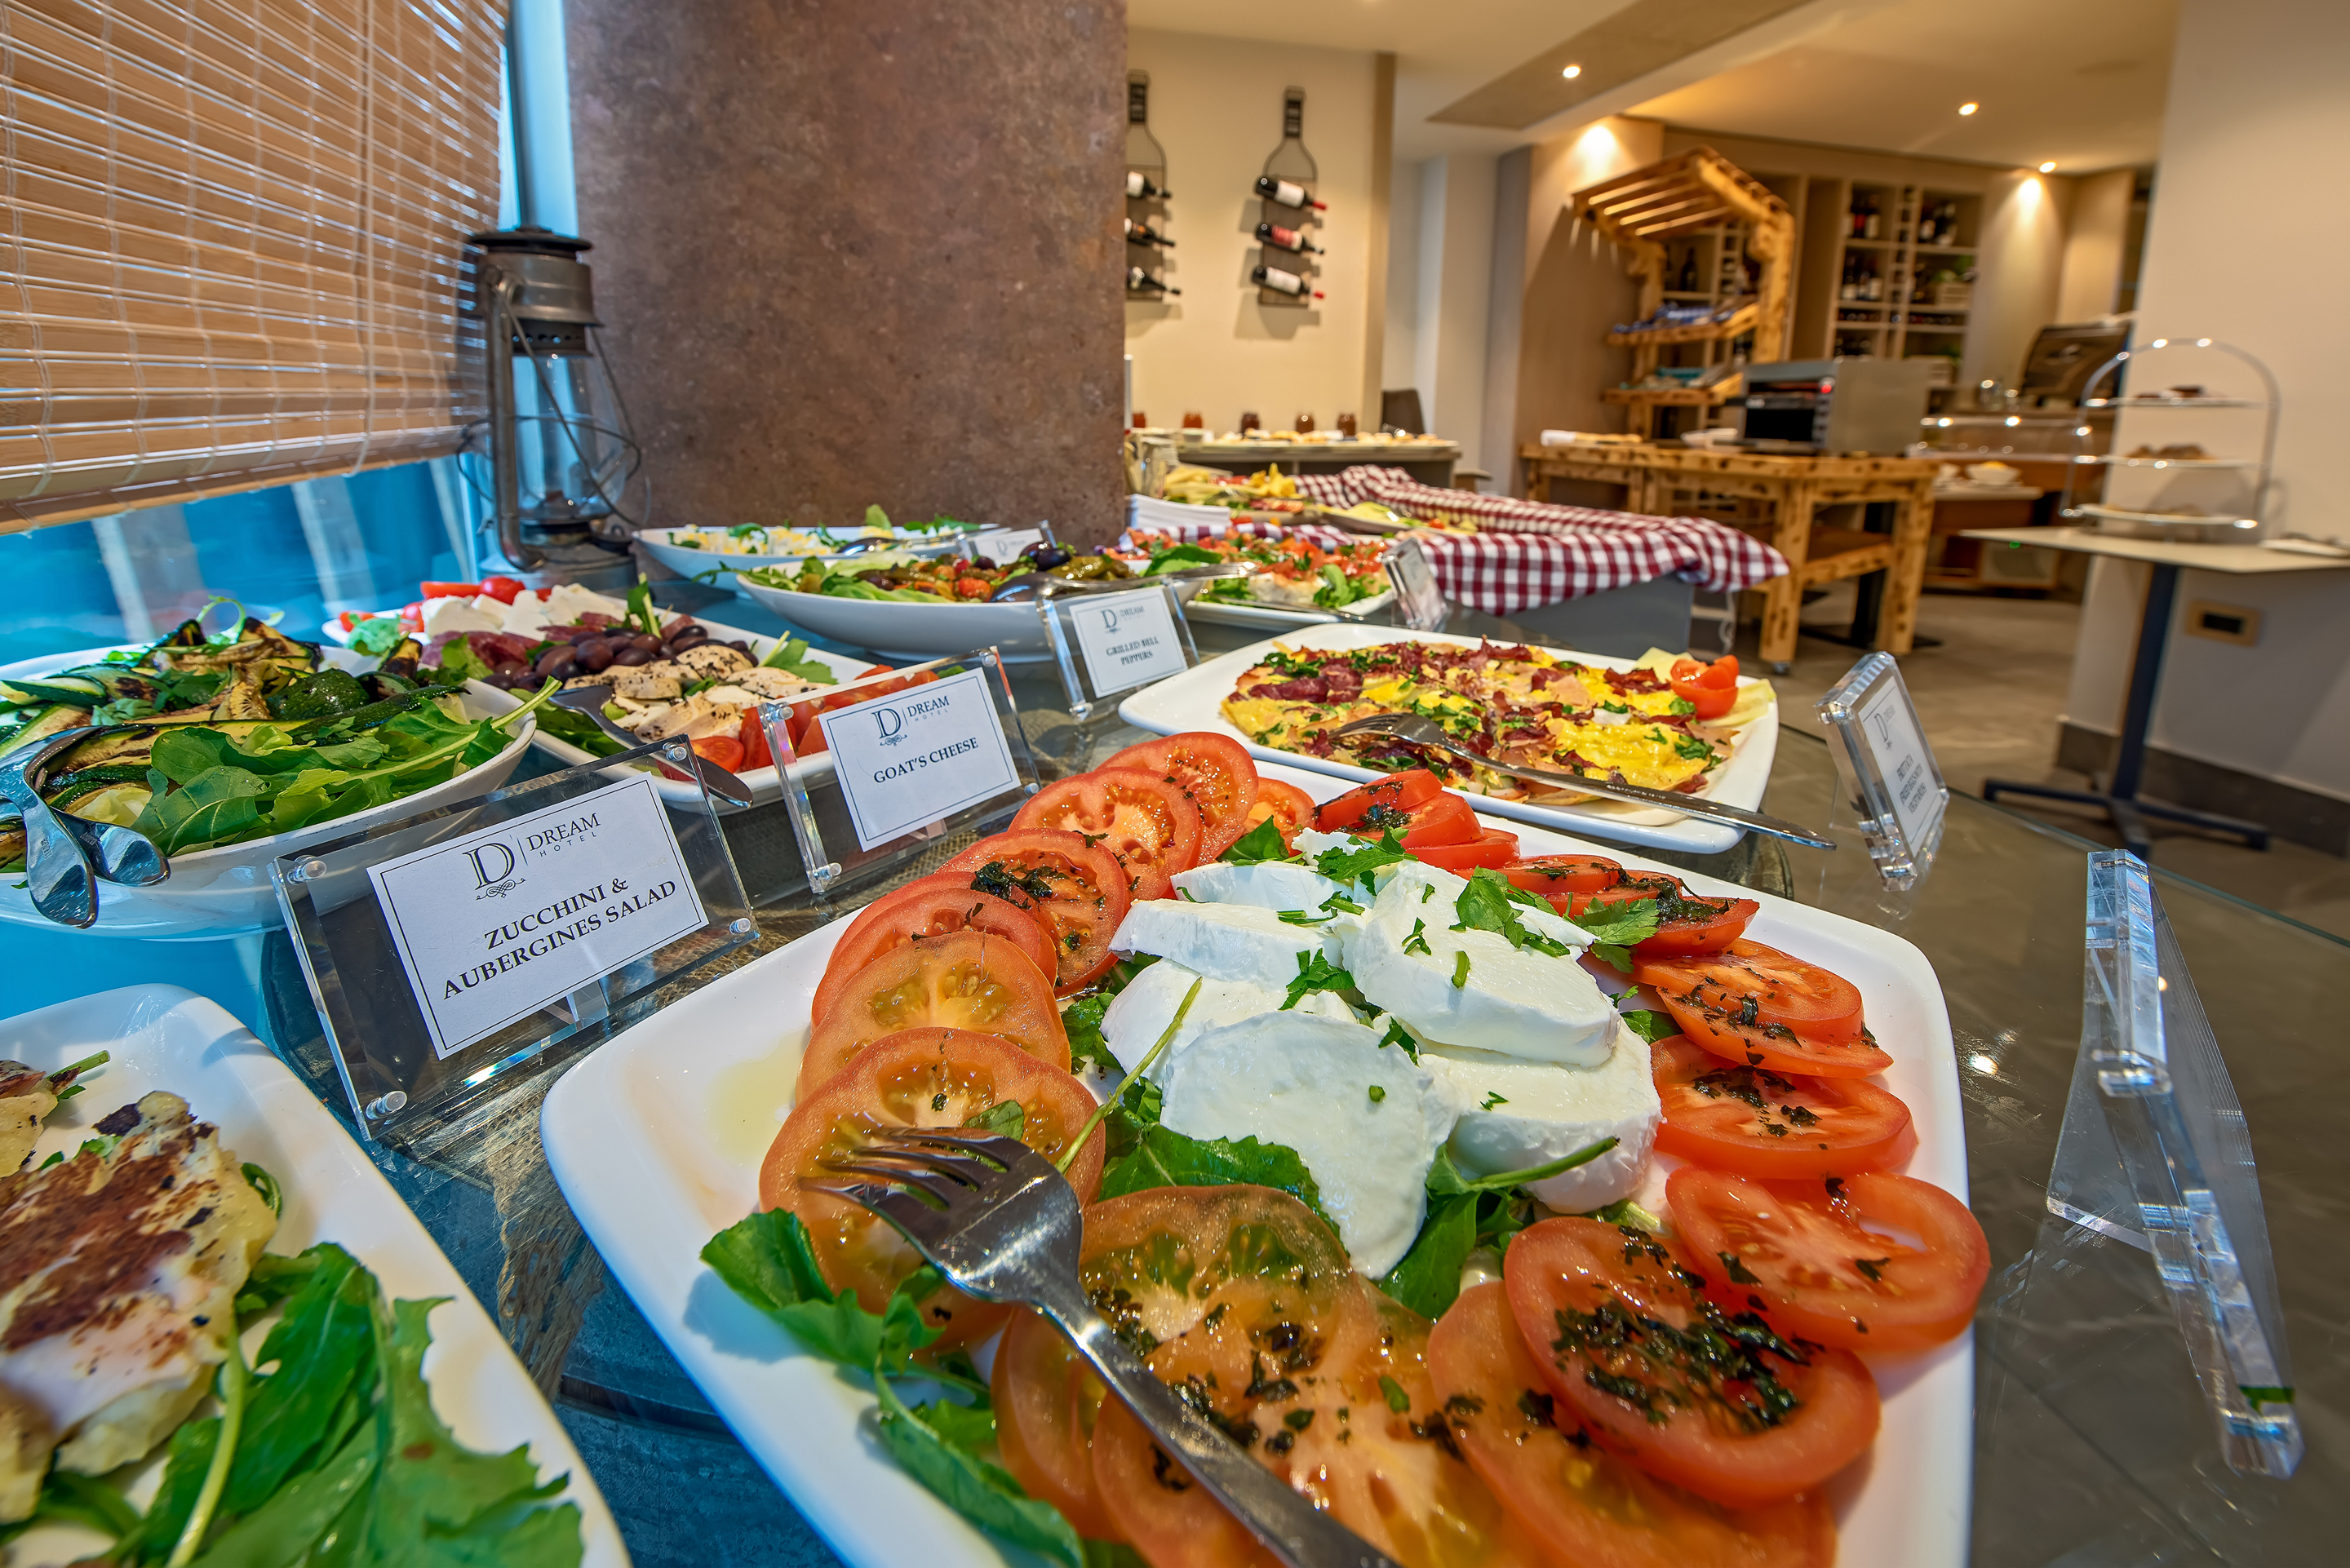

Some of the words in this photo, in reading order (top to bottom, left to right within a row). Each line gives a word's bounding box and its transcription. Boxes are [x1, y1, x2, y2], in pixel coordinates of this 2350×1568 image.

[1100, 609, 1117, 628] D
[1106, 640, 1141, 656] GRILLED
[1141, 636, 1159, 648] BELL
[1120, 650, 1153, 665] PEPPERS
[907, 695, 950, 717] DREAM
[914, 709, 947, 722] HOTEL
[871, 708, 902, 738] D
[929, 737, 978, 763] CHEESE
[526, 812, 601, 852] DREAM
[534, 832, 597, 857] HOTEL
[462, 842, 516, 890] D
[485, 884, 606, 950] ZUCCHINI
[611, 878, 629, 894] &
[443, 914, 601, 1000] AUBERGINES
[605, 880, 676, 924] SALAD
